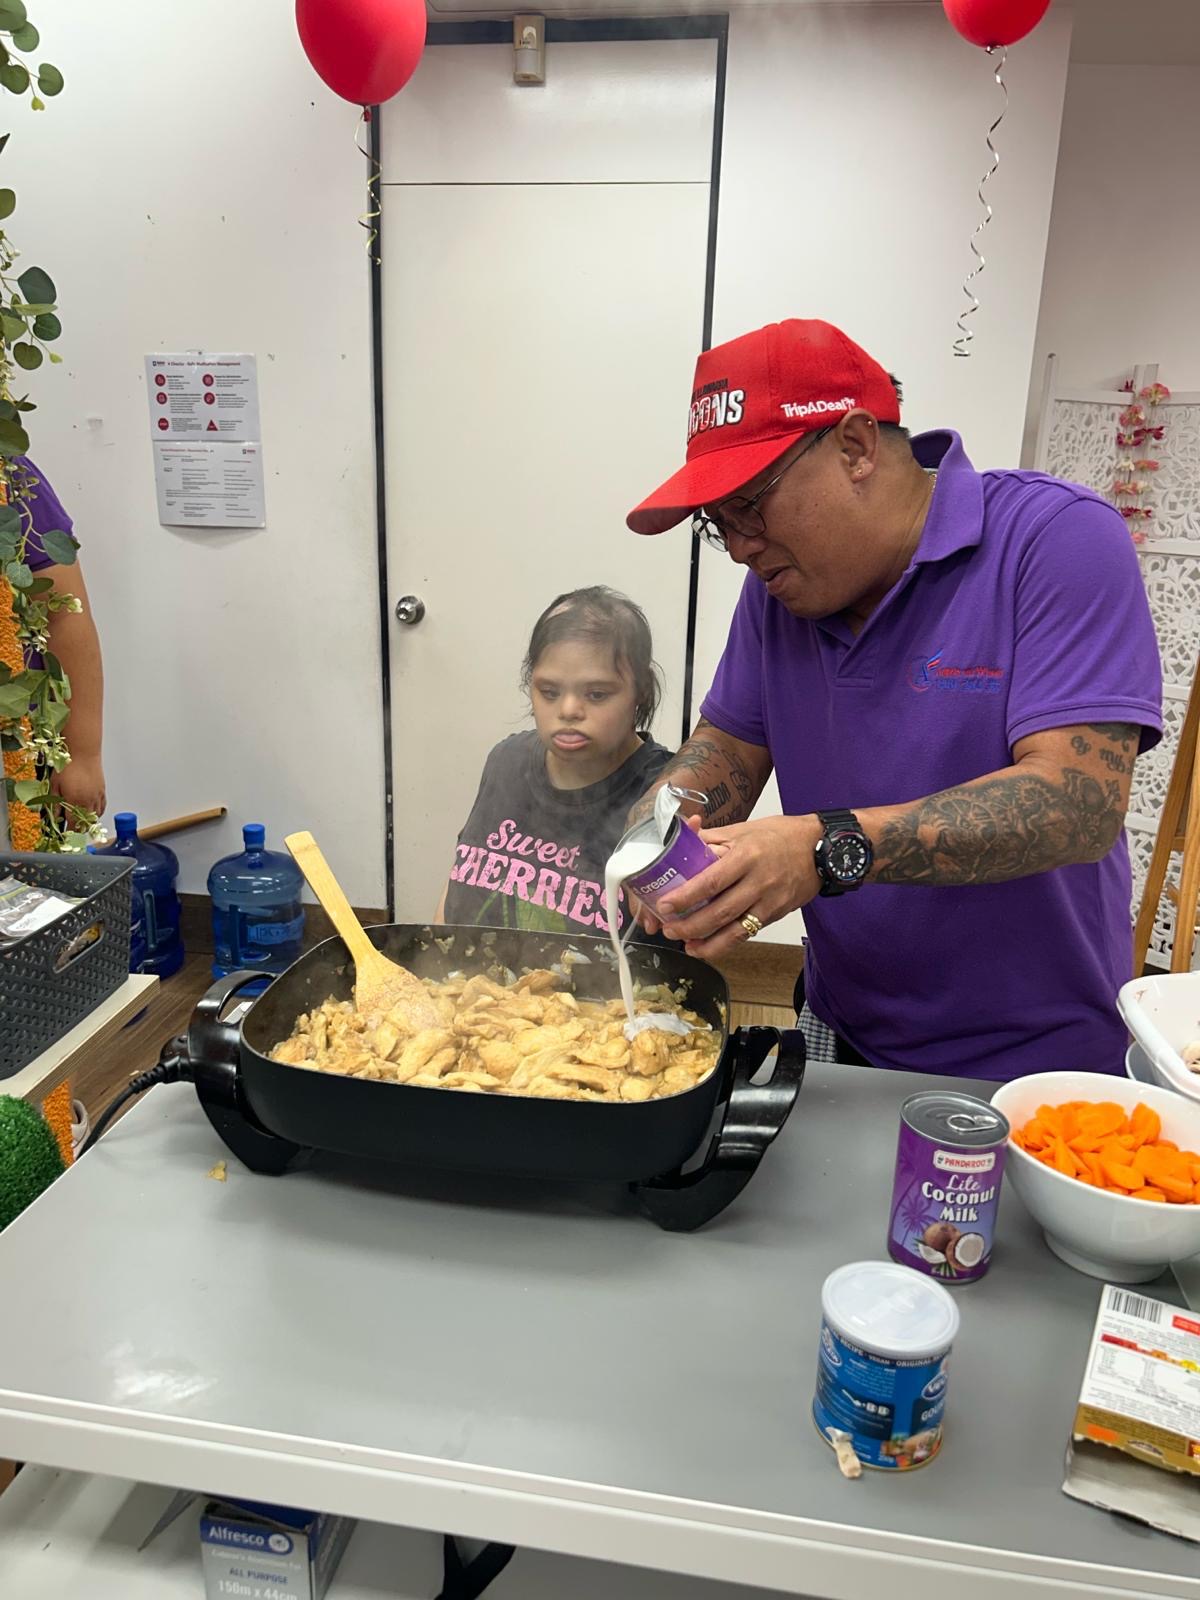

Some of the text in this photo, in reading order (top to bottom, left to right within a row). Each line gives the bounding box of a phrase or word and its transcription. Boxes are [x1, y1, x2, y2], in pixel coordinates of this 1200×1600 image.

[780, 398, 847, 418] TripADeal
[486, 819, 580, 872] Sweet
[640, 867, 678, 894] cream
[946, 1174, 981, 1191] Lite
[922, 1181, 995, 1205] Coconut
[940, 1205, 978, 1222] Milk
[896, 1358, 931, 1368] ORIGINAL
[209, 1526, 265, 1546] Alfresco
[229, 1567, 288, 1584] ALL PURPOSE
